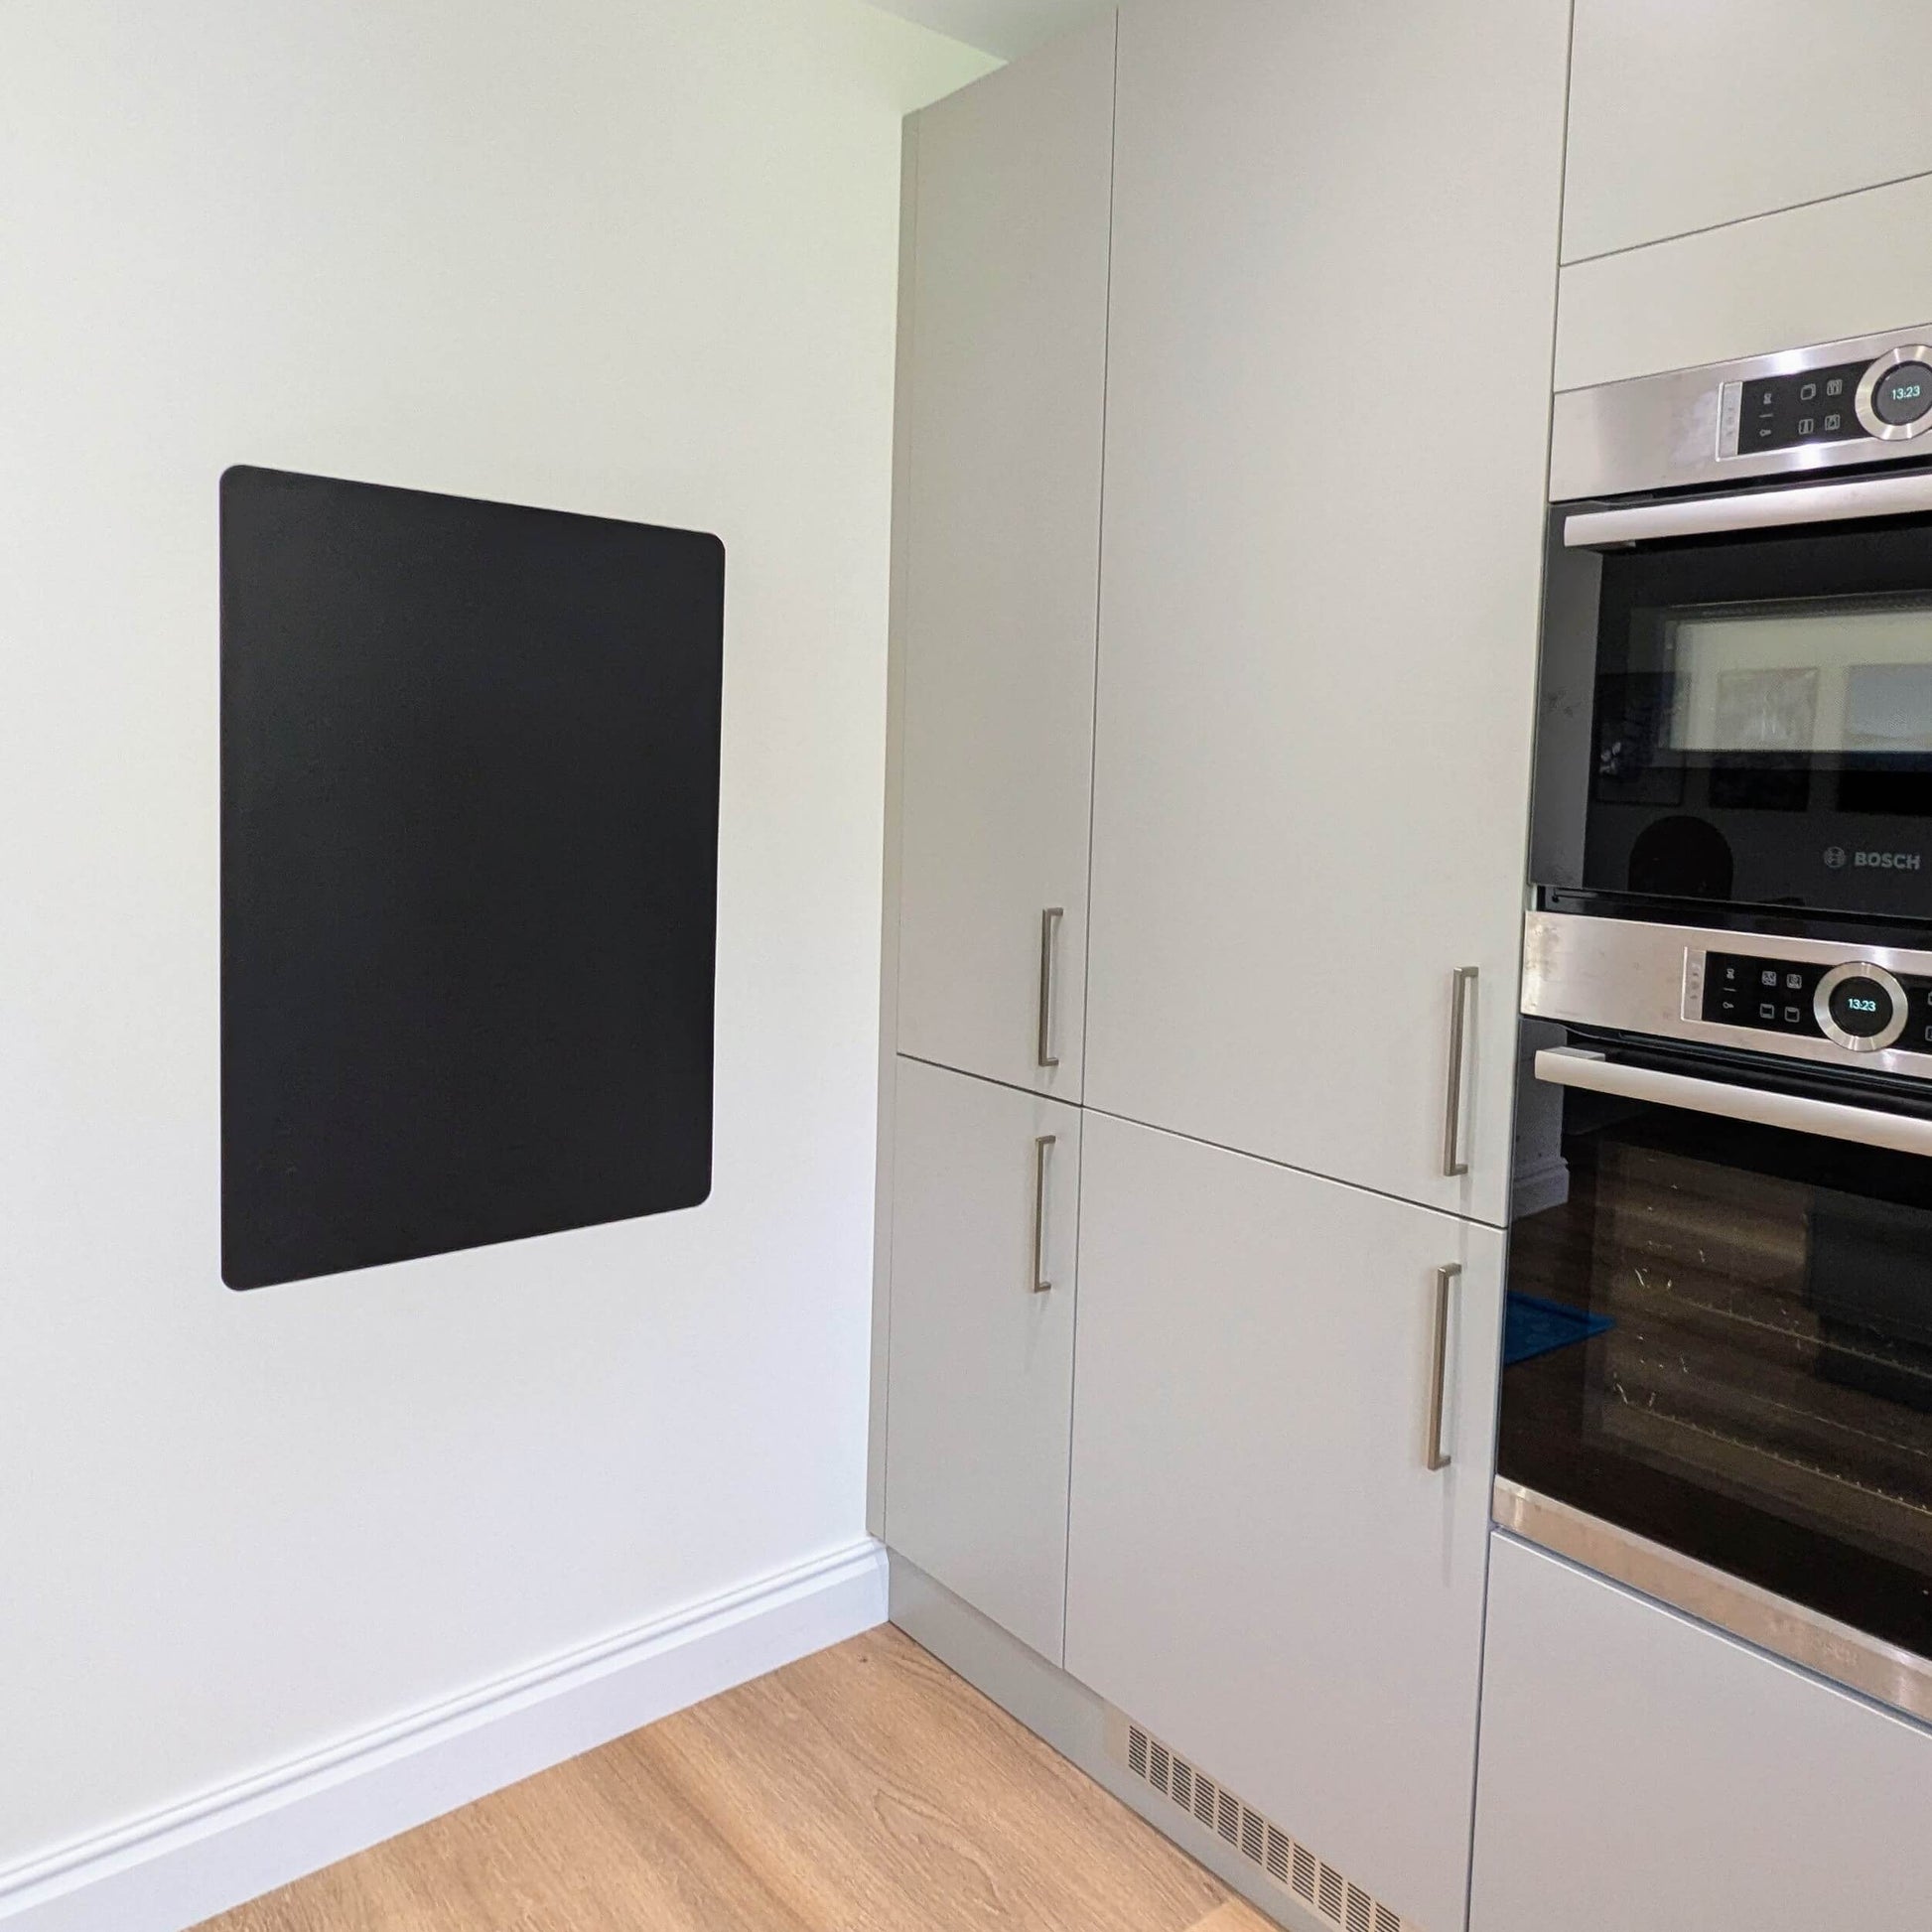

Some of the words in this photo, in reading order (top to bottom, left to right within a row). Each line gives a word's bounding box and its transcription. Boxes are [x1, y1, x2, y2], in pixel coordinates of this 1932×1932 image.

[1891, 385, 1920, 400] 13:23
[1855, 852, 1921, 870] BOSCH
[1848, 998, 1876, 1012] 13:23
